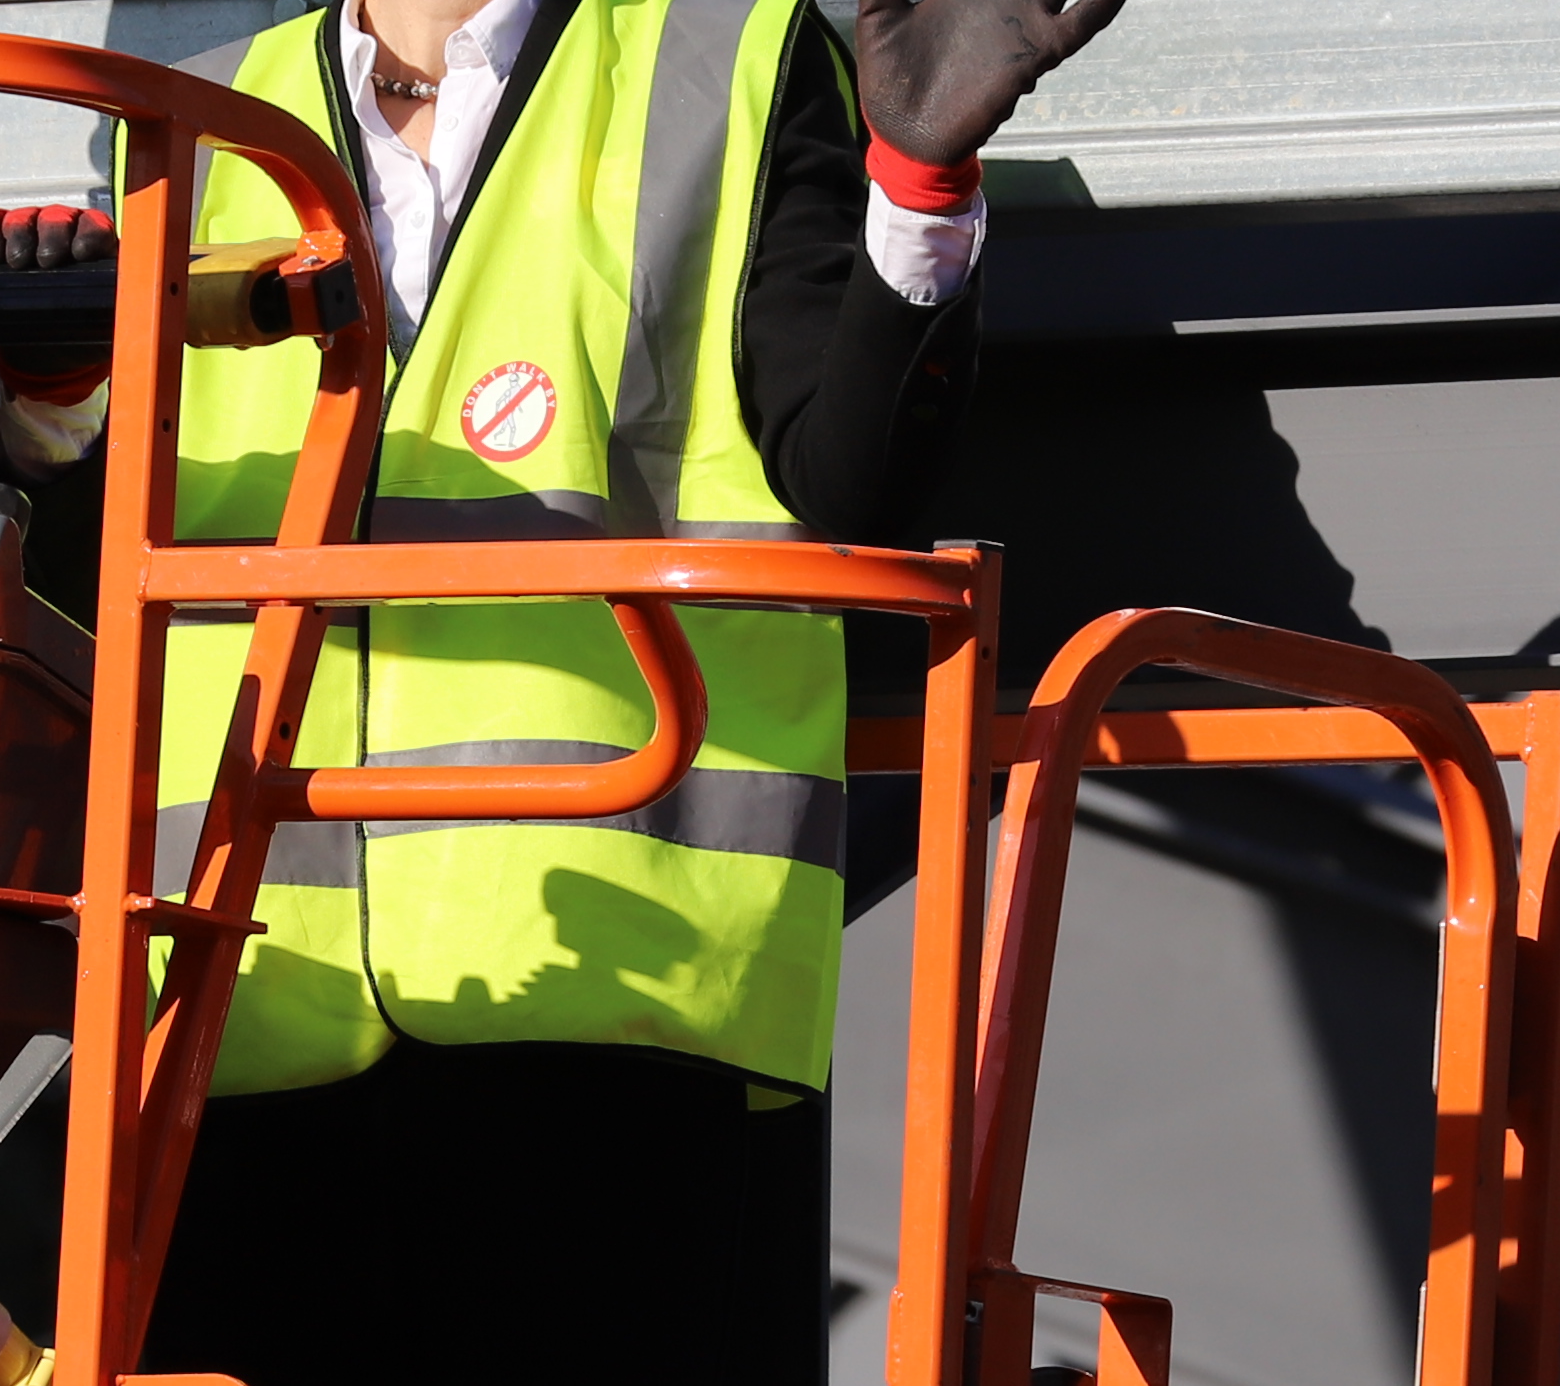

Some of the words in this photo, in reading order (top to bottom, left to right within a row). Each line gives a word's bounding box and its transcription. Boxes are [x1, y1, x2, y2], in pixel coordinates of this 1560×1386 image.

[462, 369, 498, 418] DON'T
[505, 362, 547, 383] WALK
[544, 387, 556, 409] BY
